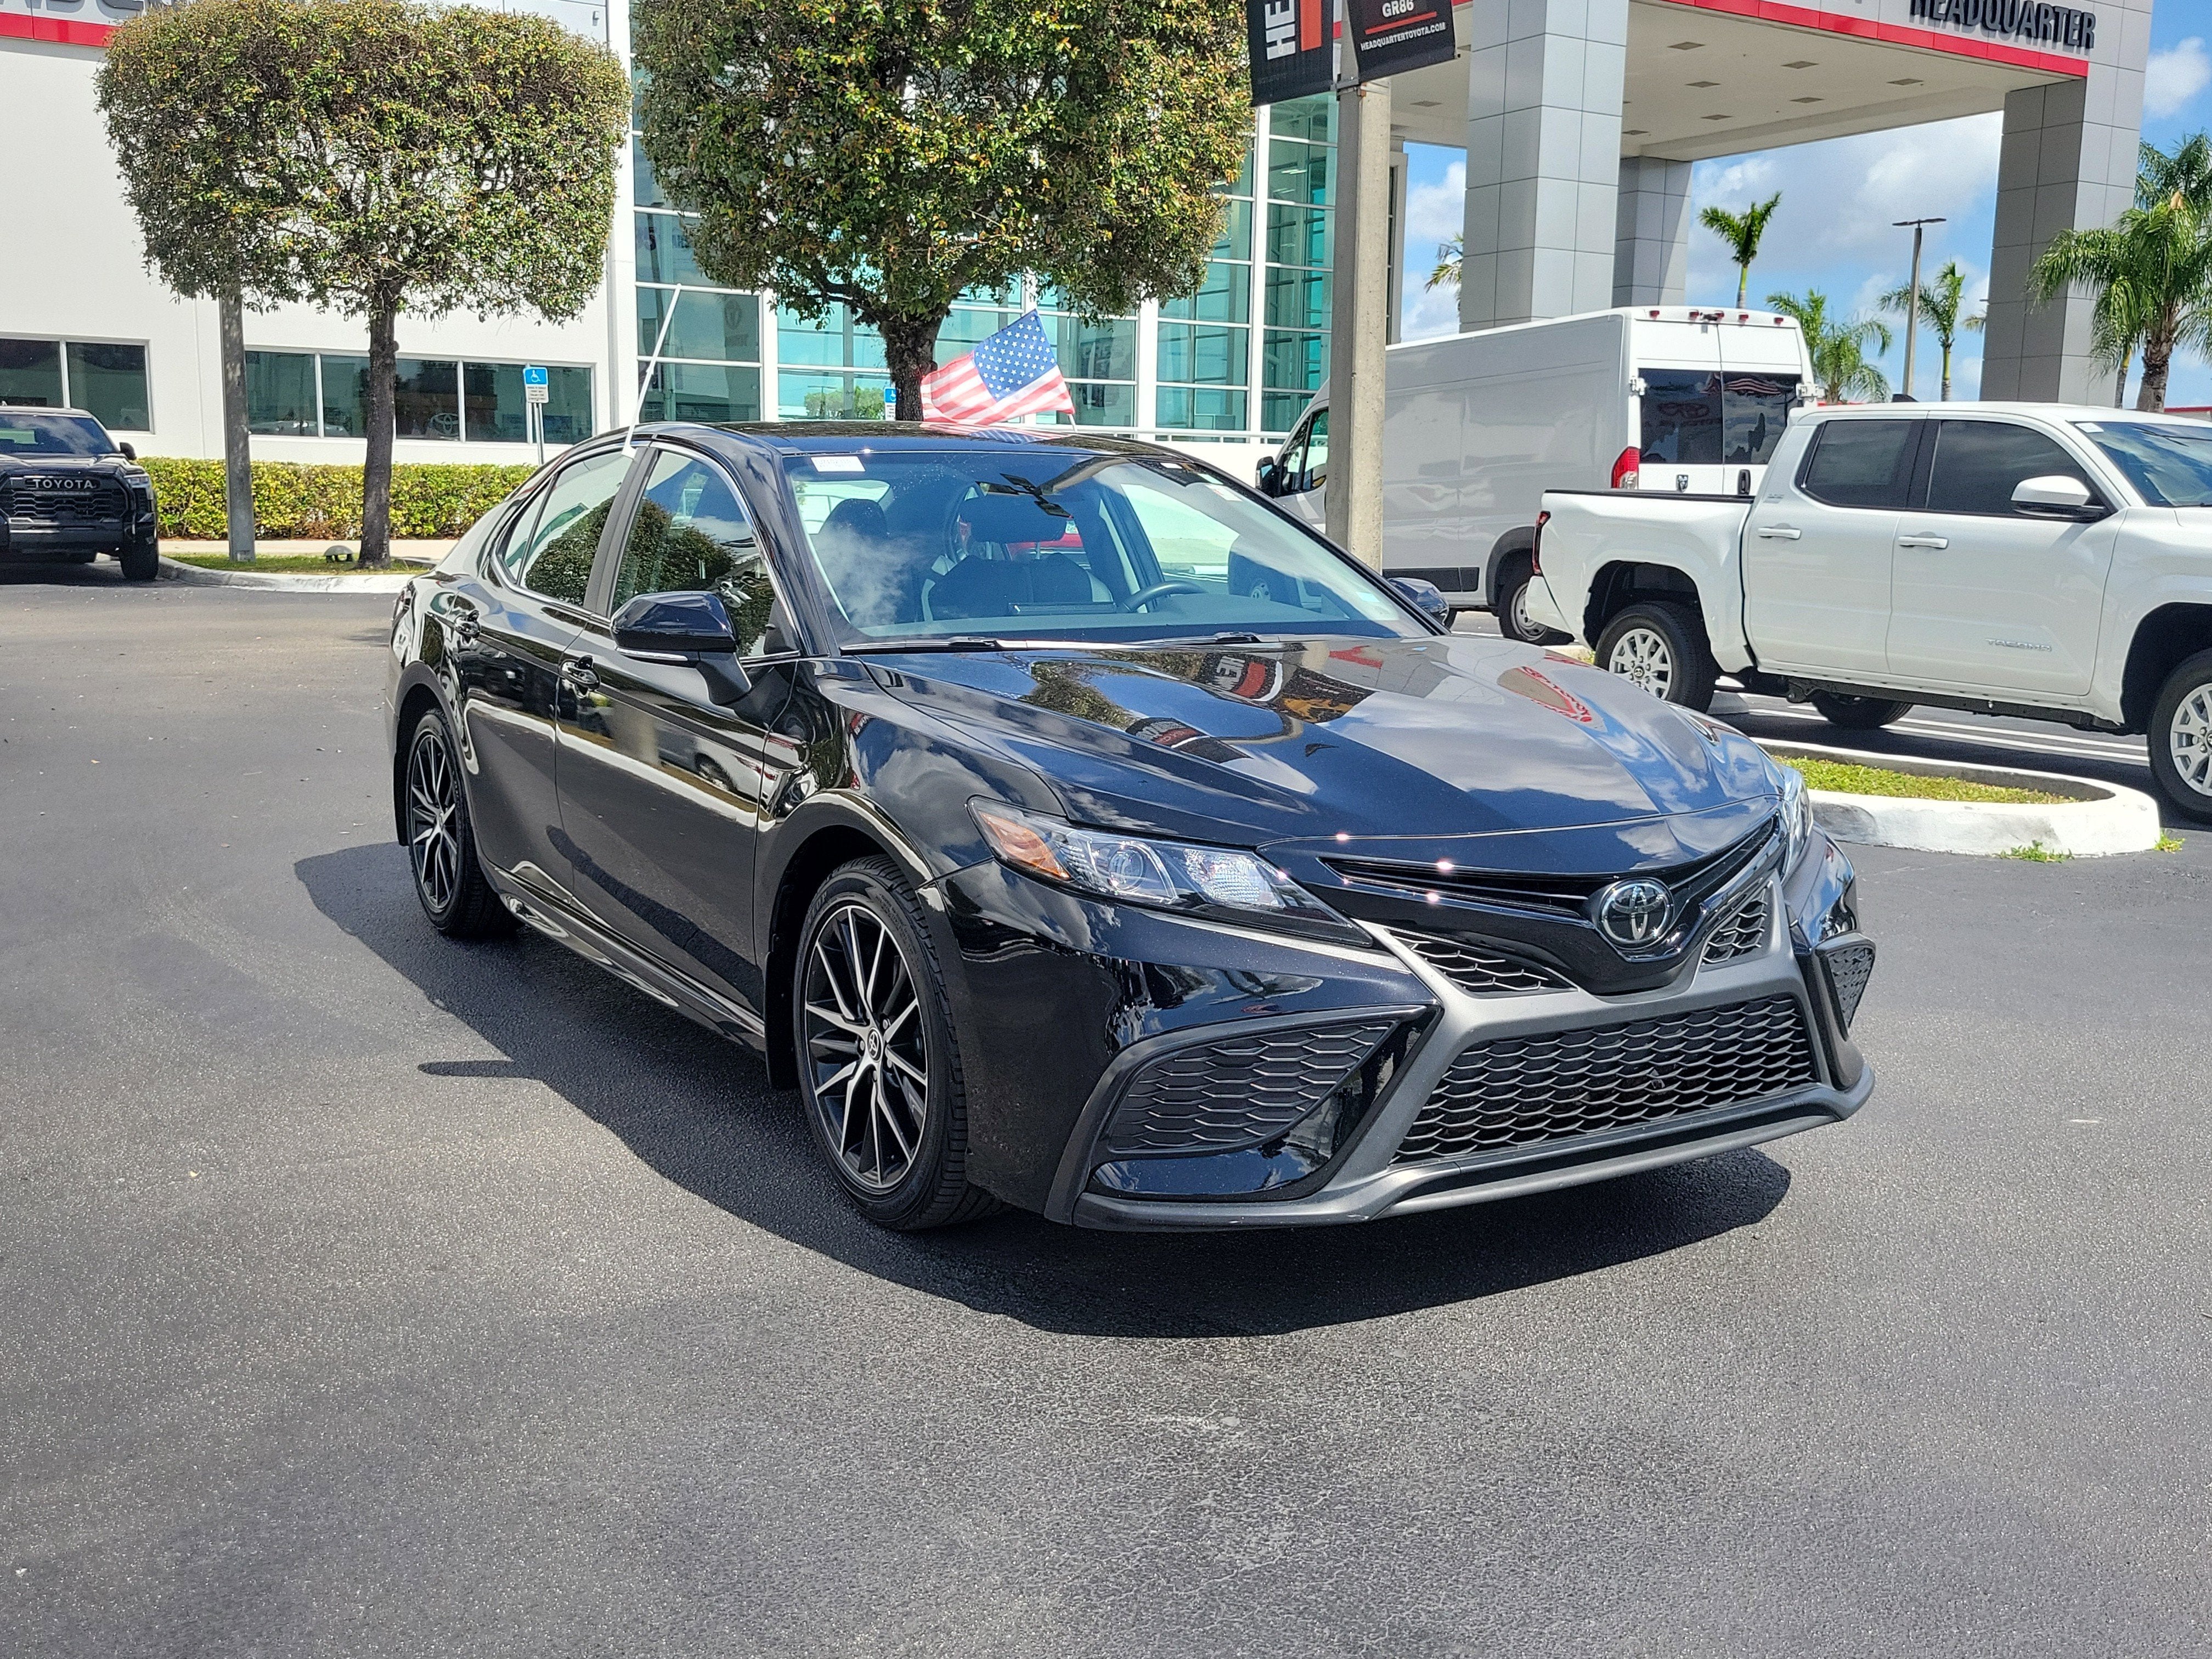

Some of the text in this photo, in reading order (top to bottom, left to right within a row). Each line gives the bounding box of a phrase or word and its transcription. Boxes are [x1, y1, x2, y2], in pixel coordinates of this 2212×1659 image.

[1382, 0, 1414, 18] GR86
[1360, 21, 1446, 52] HEADQUARTERTOYOTA.COM
[32, 479, 94, 489] TOYOTA
[1984, 638, 2052, 652] TACOMA
